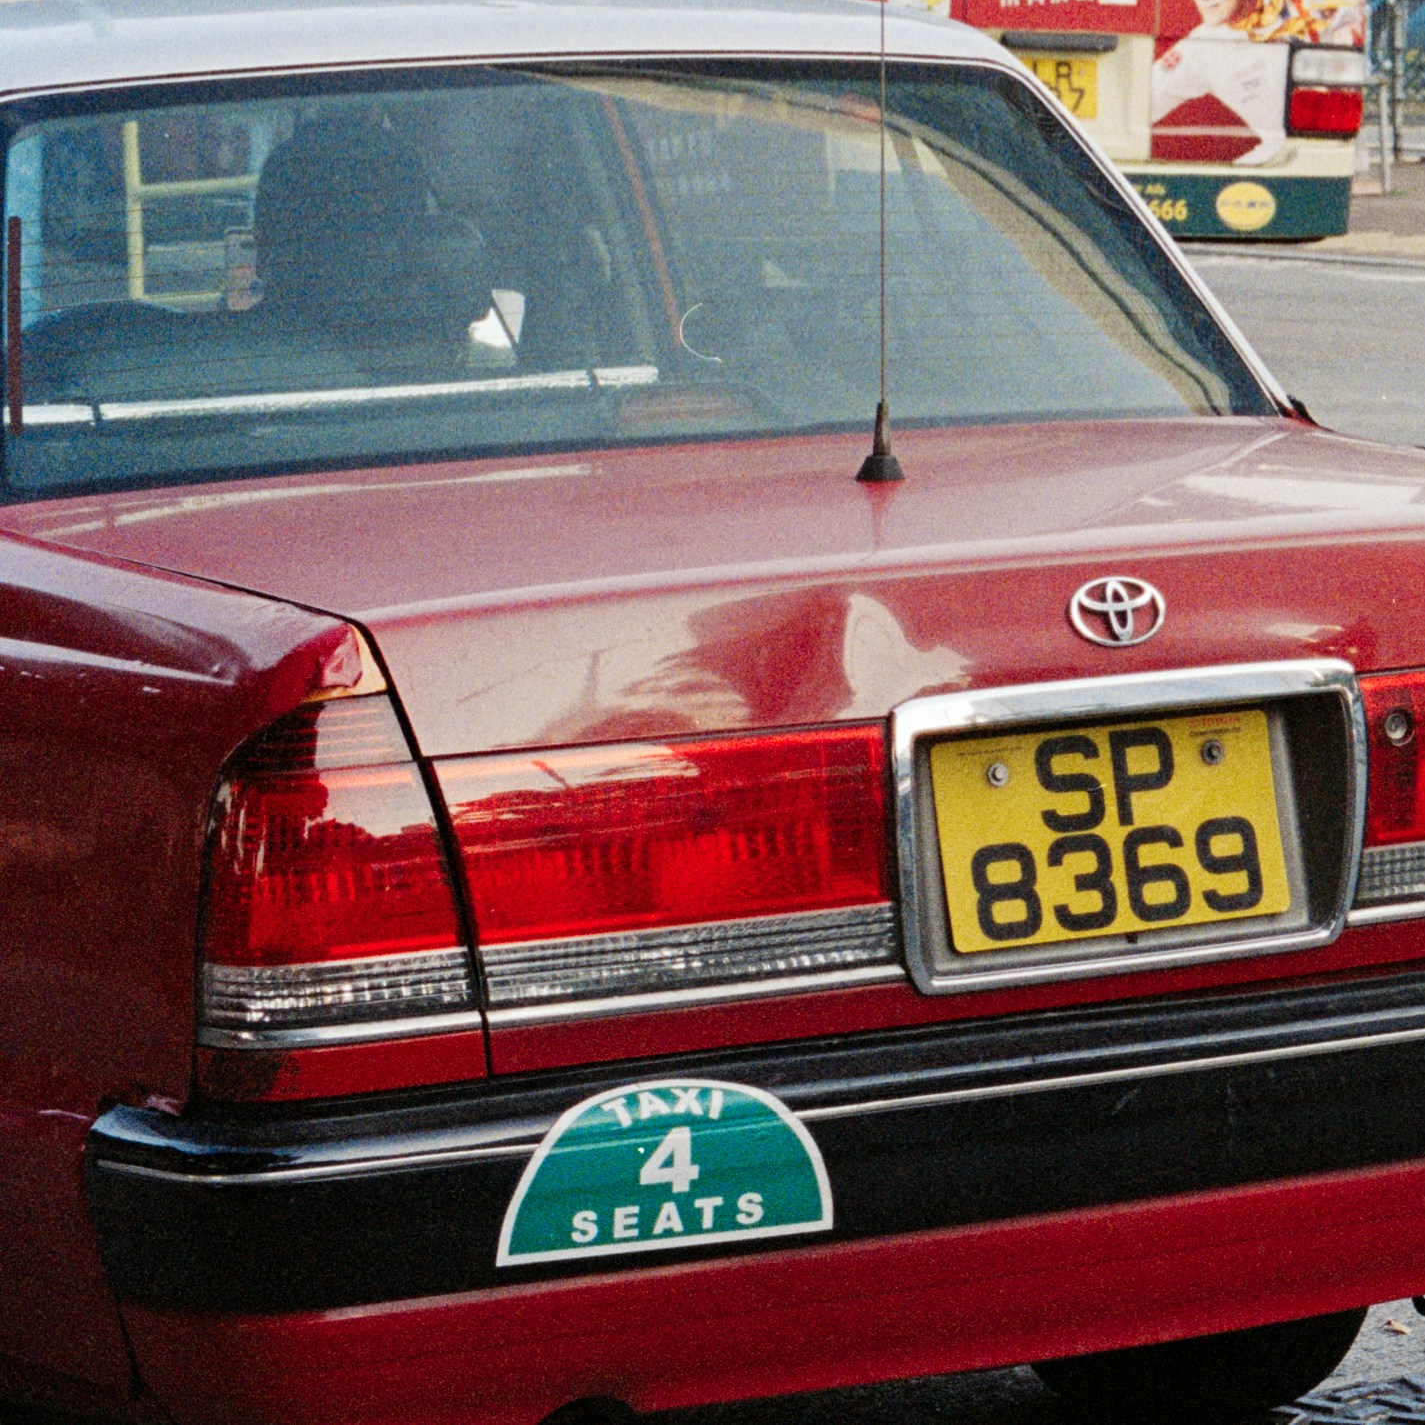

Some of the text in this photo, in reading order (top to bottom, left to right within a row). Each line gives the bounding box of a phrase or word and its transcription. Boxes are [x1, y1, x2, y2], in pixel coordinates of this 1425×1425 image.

[1034, 727, 1175, 833] SP
[971, 816, 1263, 941] 8369
[602, 1087, 723, 1128] TAXI
[639, 1127, 699, 1193] 4
[571, 1192, 764, 1244] SEATS
